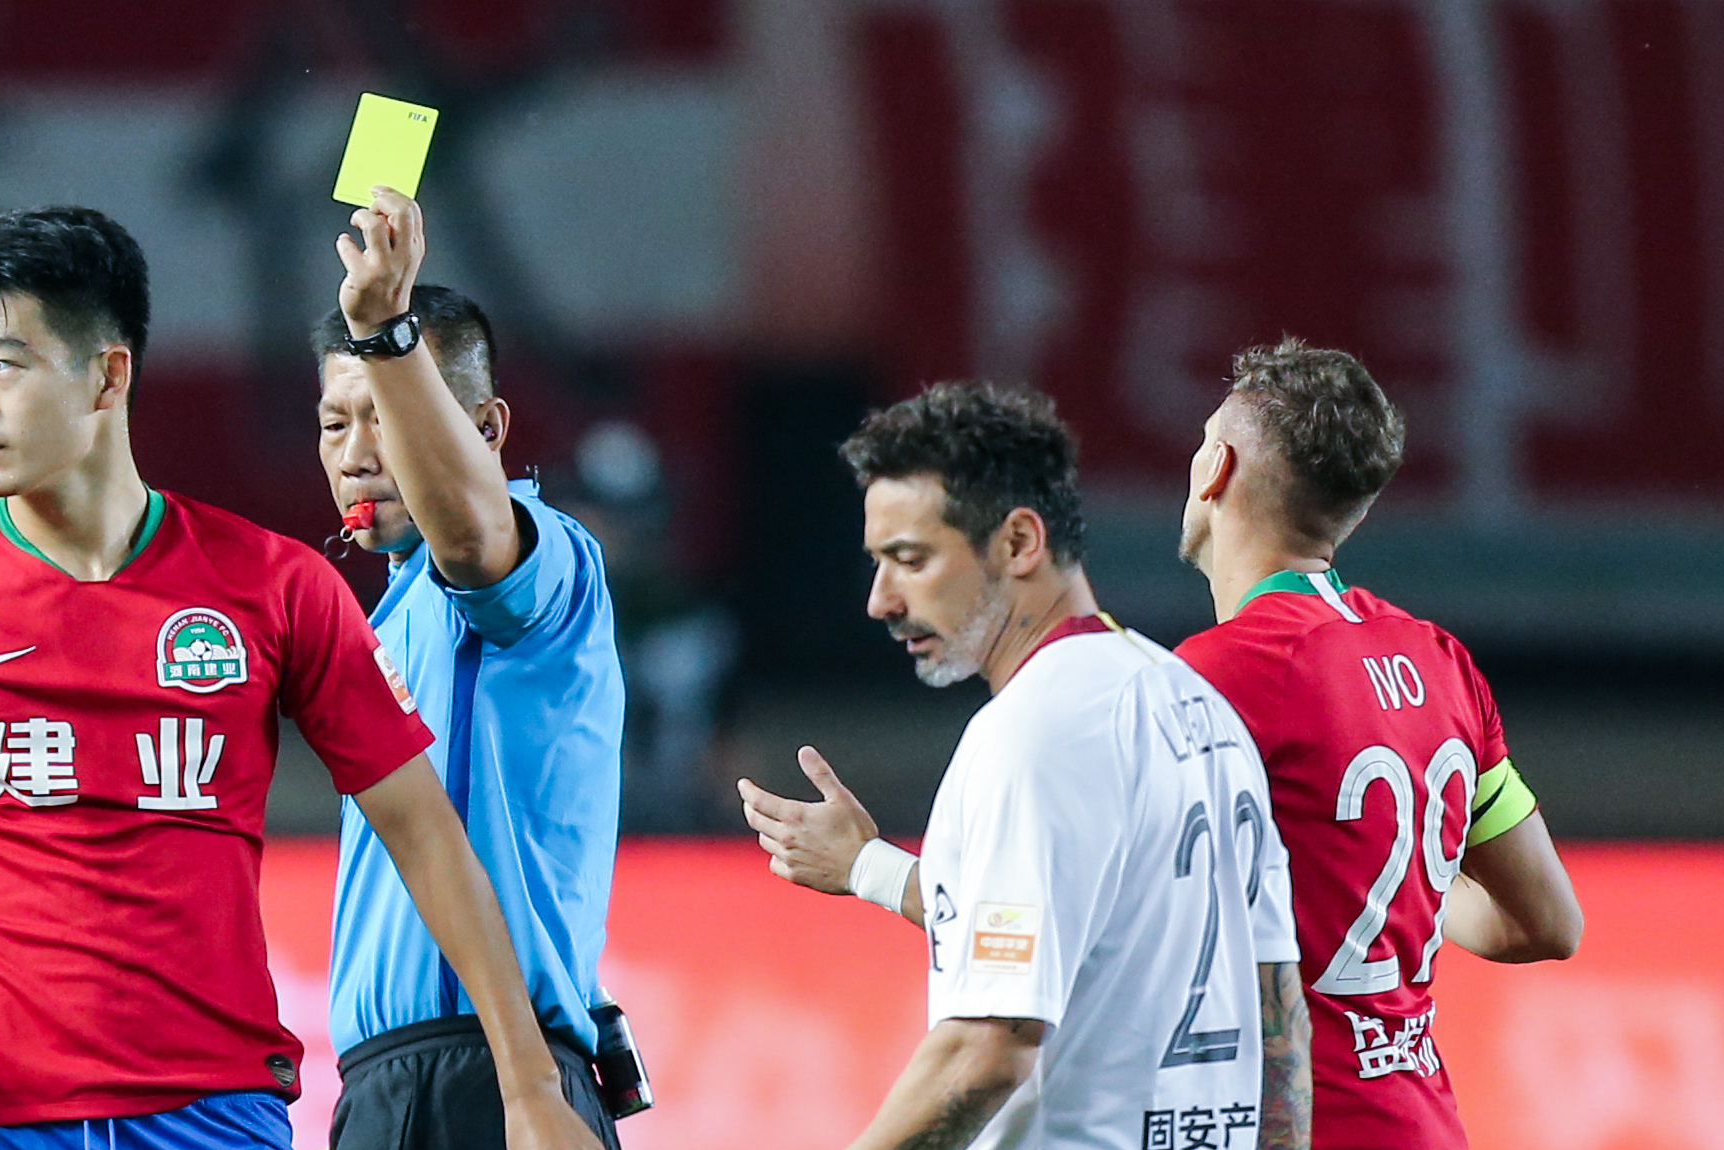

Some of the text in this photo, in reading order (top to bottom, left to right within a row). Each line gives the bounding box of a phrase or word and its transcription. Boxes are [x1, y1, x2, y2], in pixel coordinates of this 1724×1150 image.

[407, 111, 429, 123] FIFA
[1361, 653, 1426, 711] IVO
[1310, 736, 1477, 996] 29
